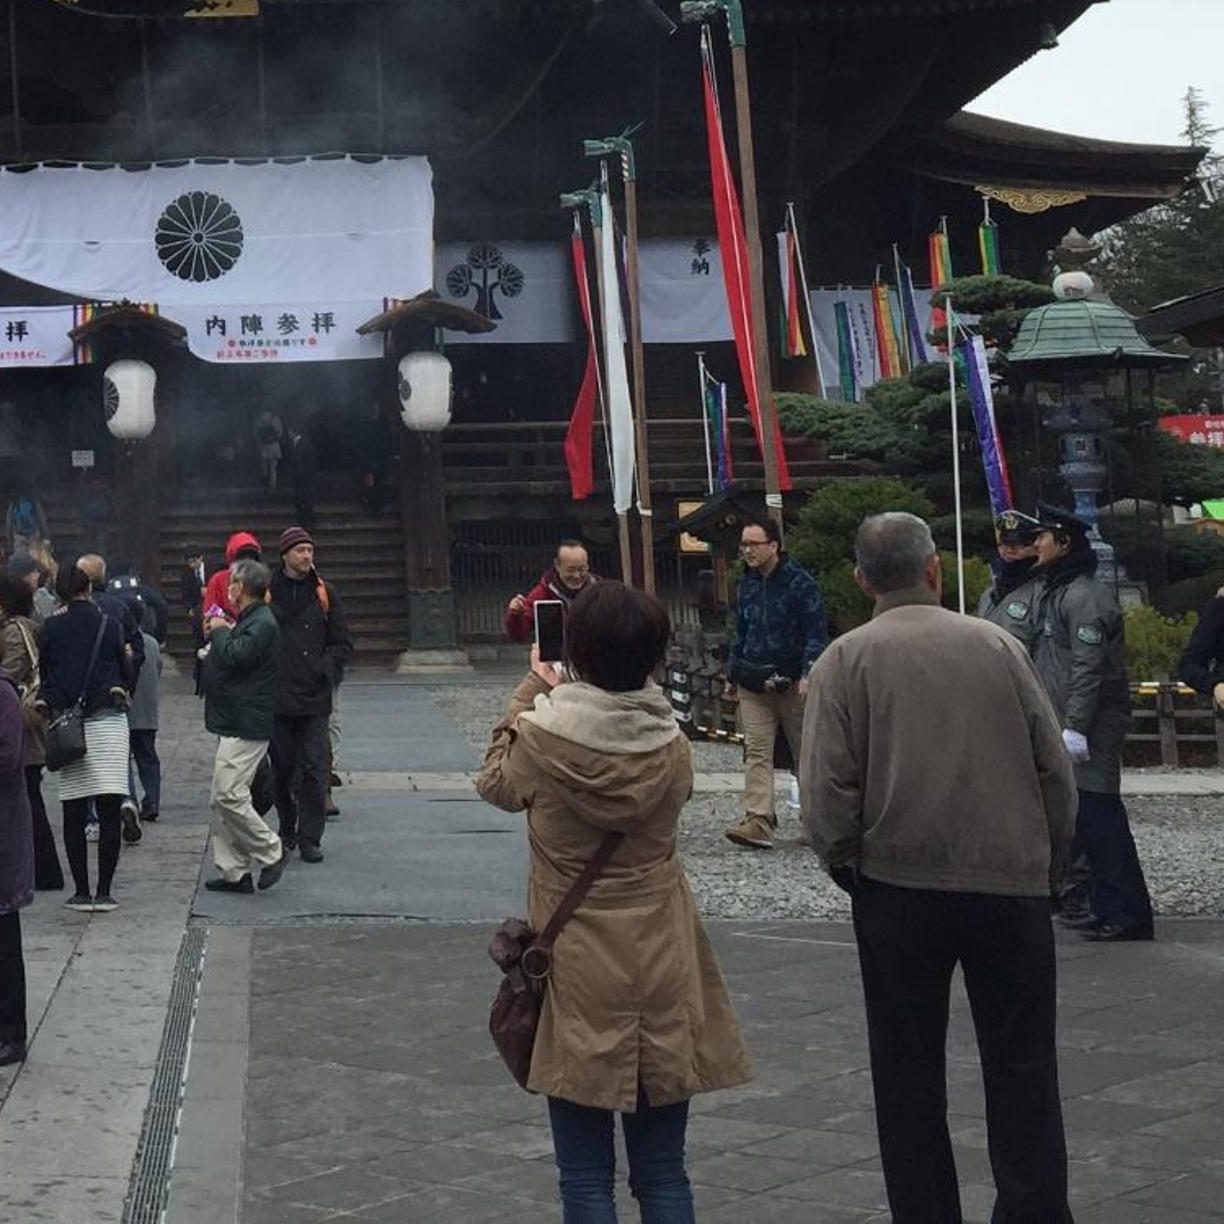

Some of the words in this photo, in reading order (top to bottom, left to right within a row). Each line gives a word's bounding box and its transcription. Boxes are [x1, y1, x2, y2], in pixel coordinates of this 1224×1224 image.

[691, 237, 711, 276] 奉納
[205, 311, 337, 337] 内陣参拝
